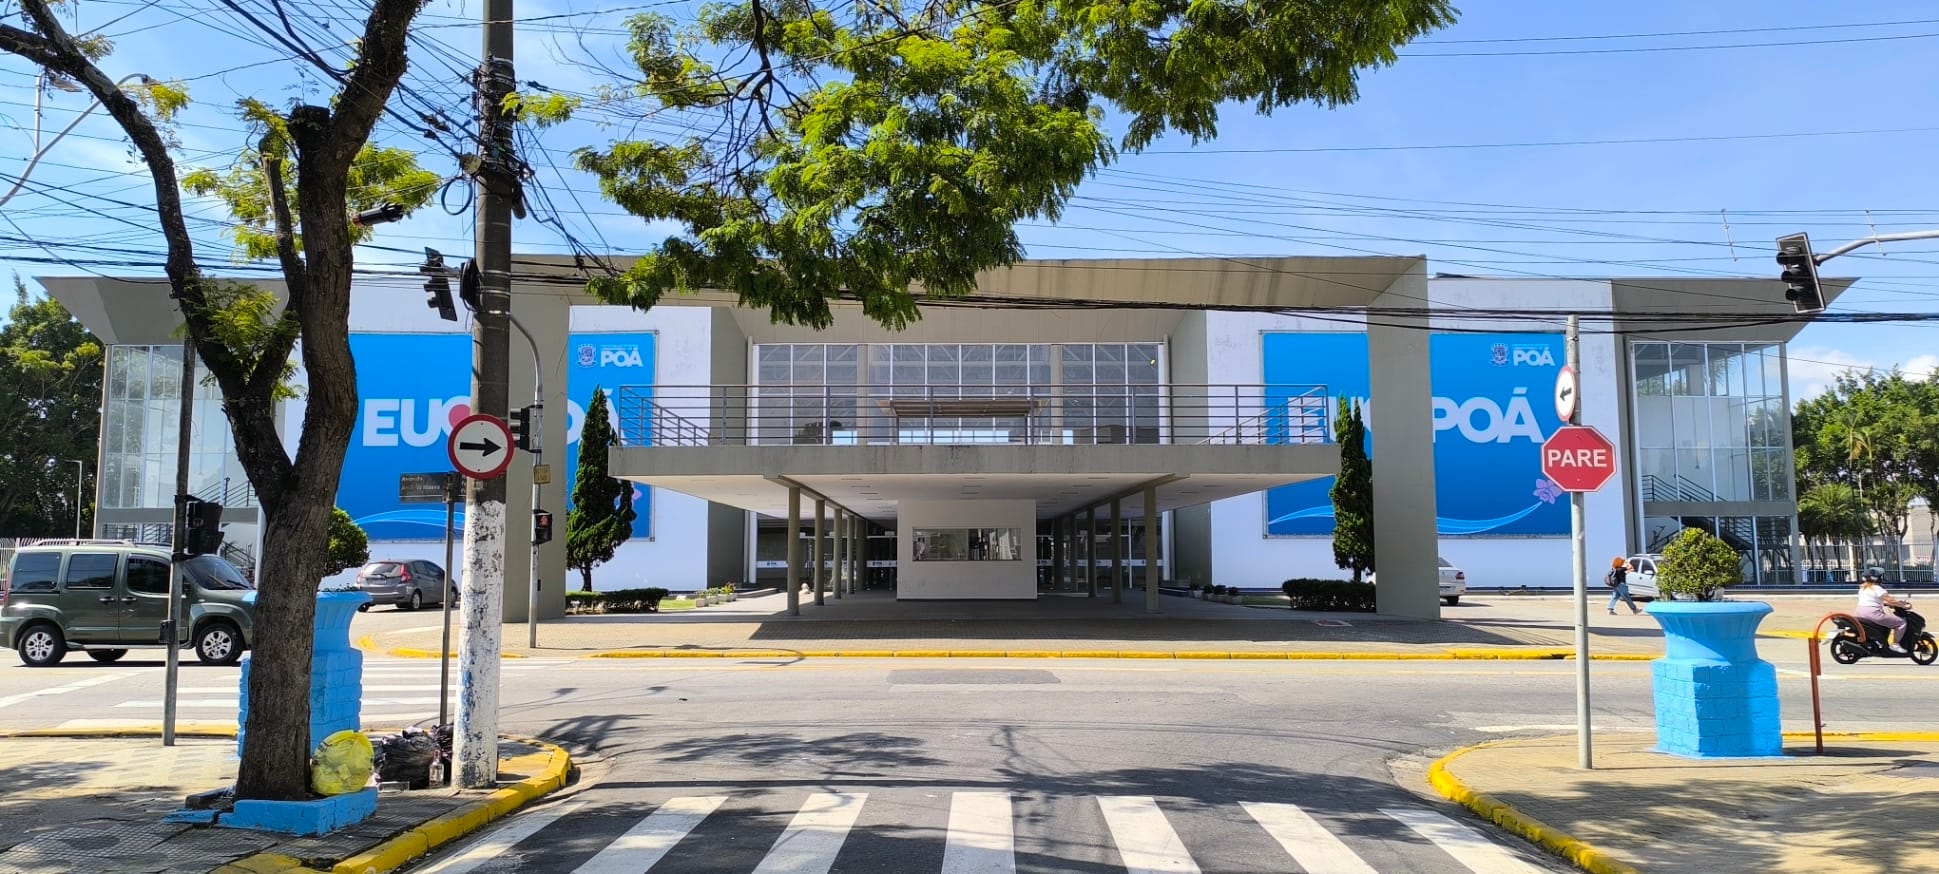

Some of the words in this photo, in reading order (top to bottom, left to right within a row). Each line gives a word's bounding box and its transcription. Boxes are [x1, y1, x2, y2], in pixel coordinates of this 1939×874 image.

[600, 347, 644, 367] POÁ
[1513, 346, 1555, 366] POÁ
[1433, 387, 1545, 443] POÁ
[1547, 449, 1608, 468] PARE
